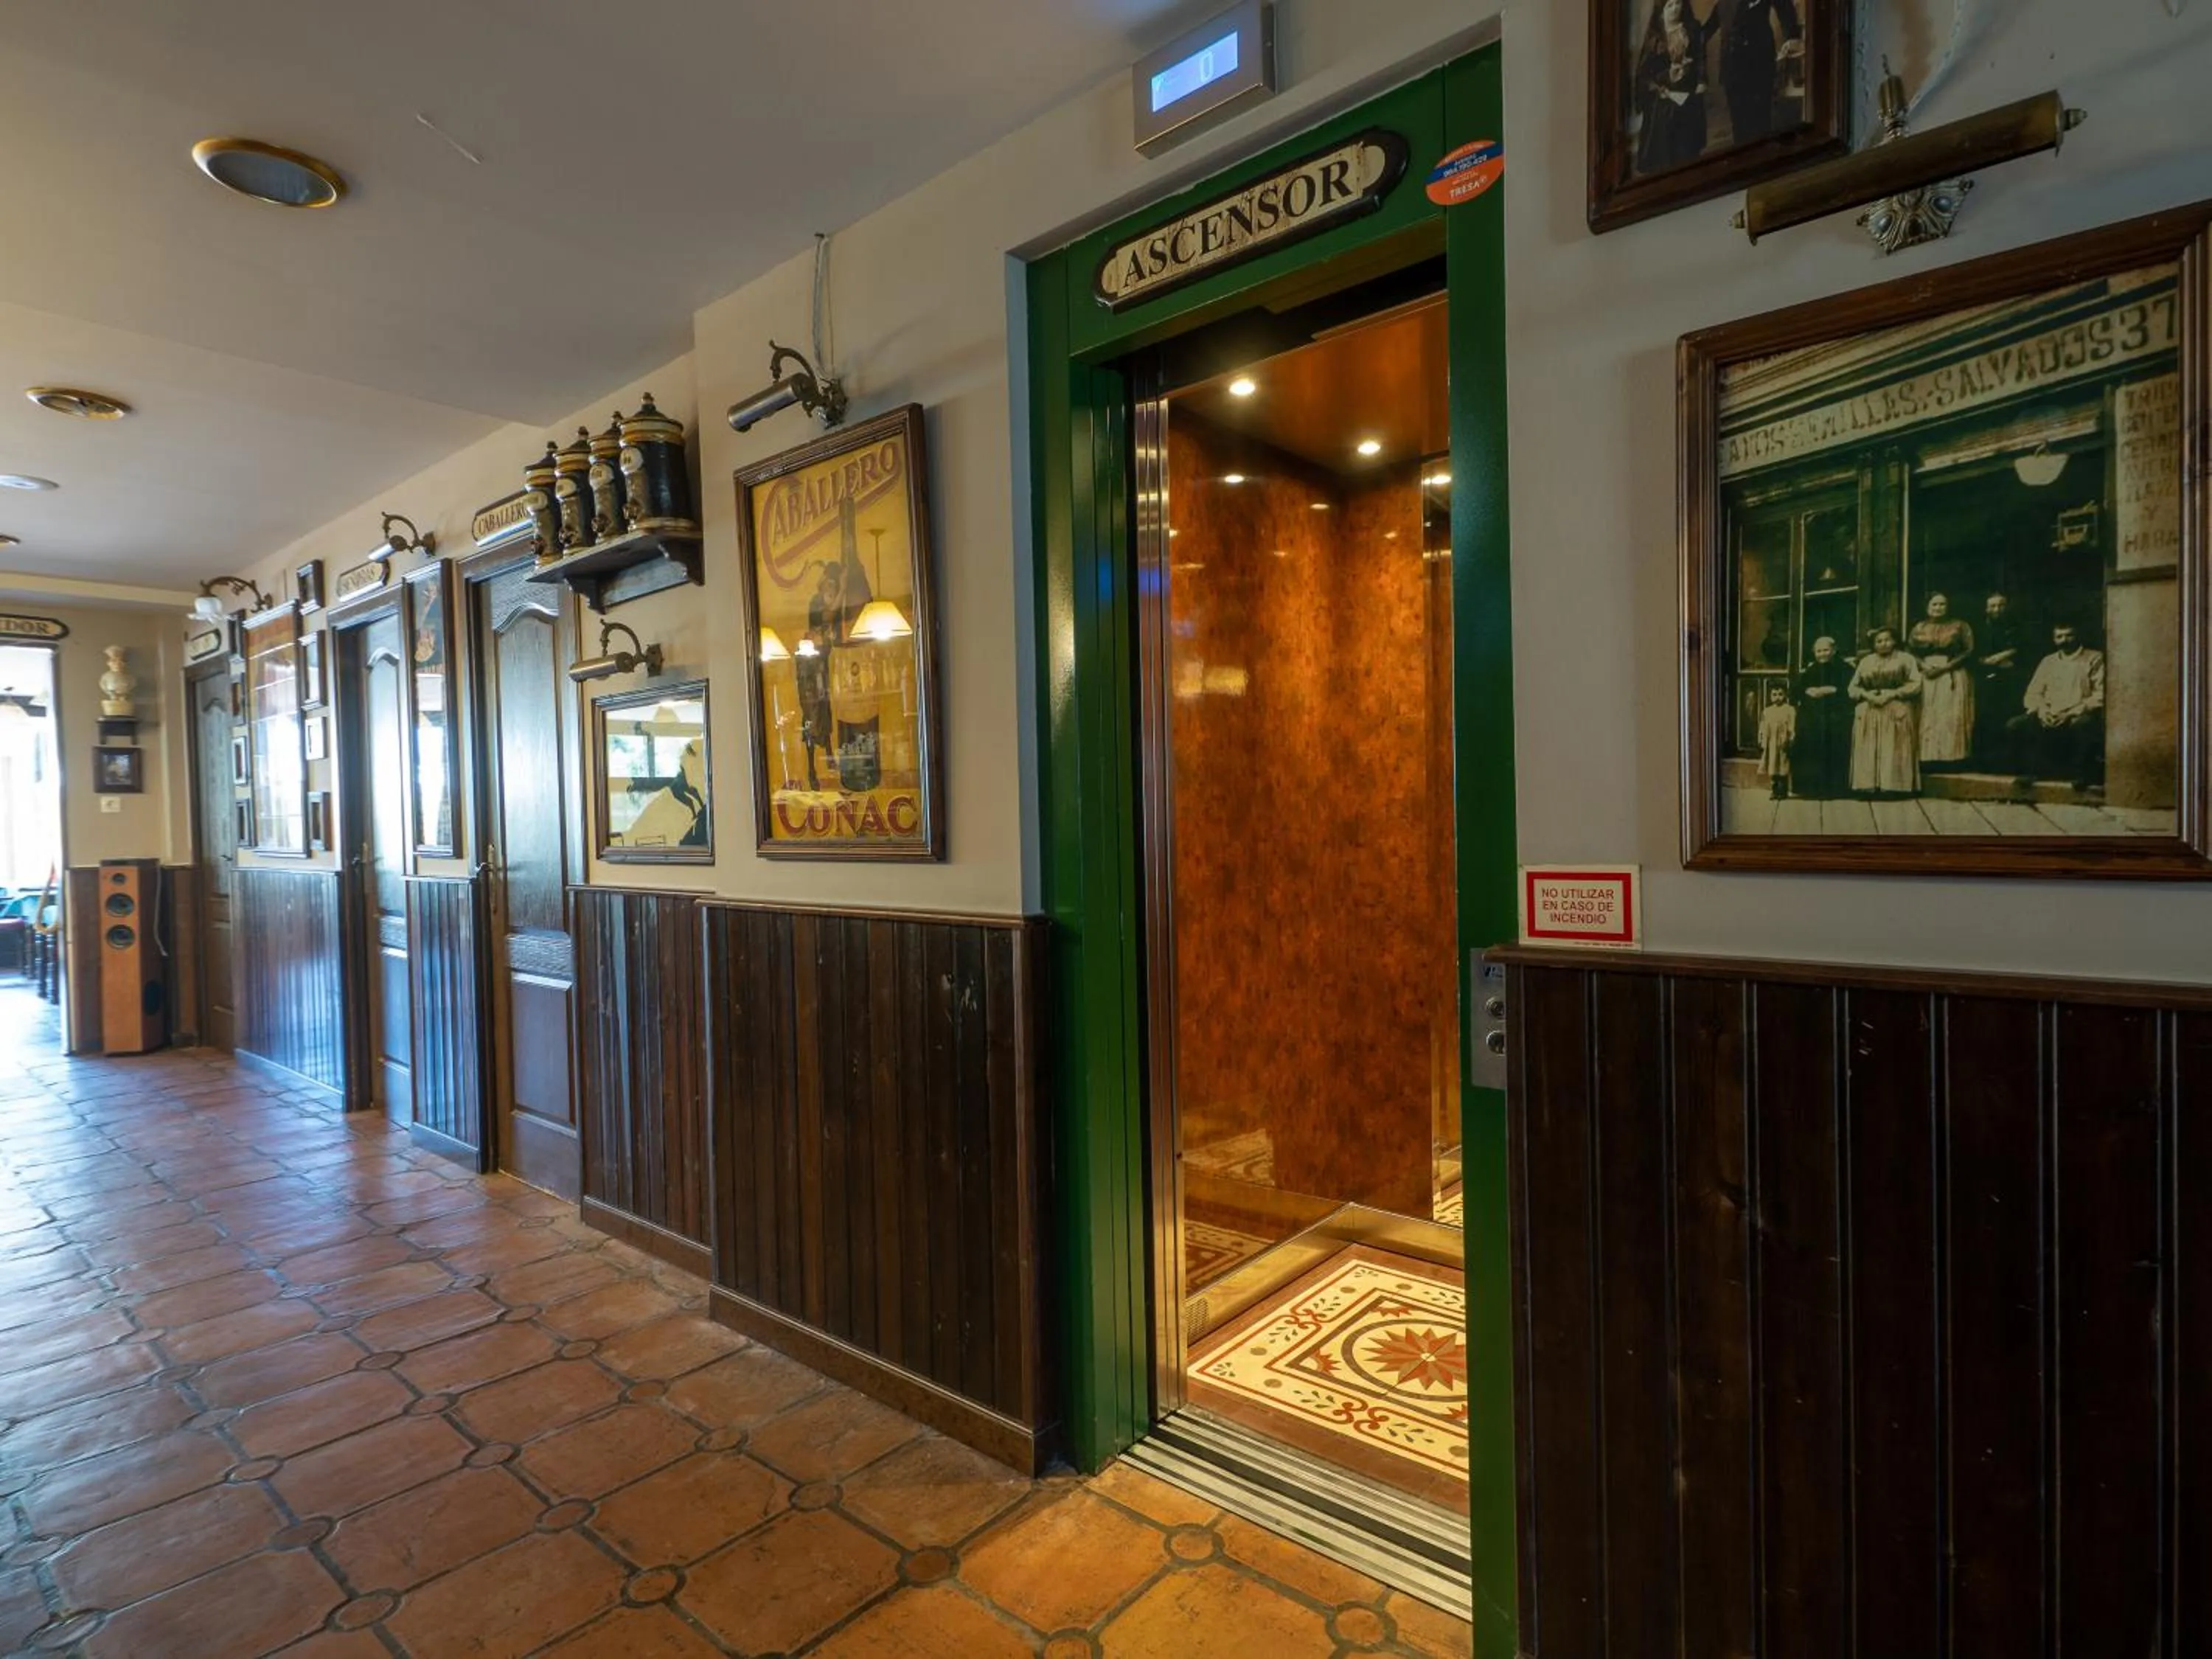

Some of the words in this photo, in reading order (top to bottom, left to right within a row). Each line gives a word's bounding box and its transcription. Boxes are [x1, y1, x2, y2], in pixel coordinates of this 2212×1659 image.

[1199, 50, 1214, 83] 0
[1123, 159, 1352, 289] ASCENSOR
[478, 501, 528, 535] CABALLER
[760, 441, 902, 589] CABALLERO
[1542, 888, 1558, 898] NO
[1561, 888, 1614, 899] UTILIZAR
[1543, 900, 1558, 911] EN
[1561, 900, 1594, 911] CASO
[1598, 902, 1614, 912] DE
[1550, 913, 1607, 924] INCENDIO
